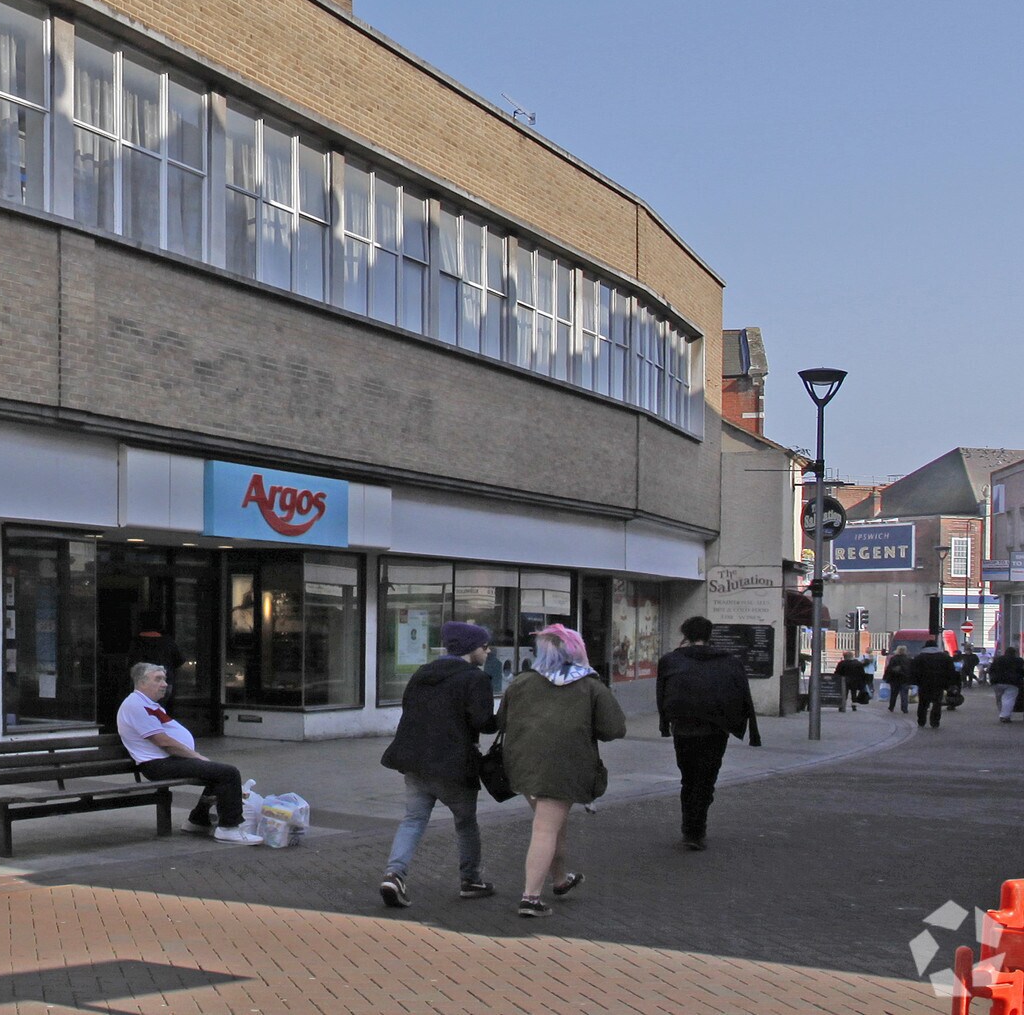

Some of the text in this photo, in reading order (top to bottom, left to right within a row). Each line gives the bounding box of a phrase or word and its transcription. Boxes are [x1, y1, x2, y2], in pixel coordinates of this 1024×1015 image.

[240, 472, 328, 537] Argos
[804, 509, 843, 528] Salation
[854, 532, 891, 541] IPSWICH
[835, 545, 910, 561] REGENT
[717, 569, 737, 580] The
[709, 575, 774, 593] Salutation
